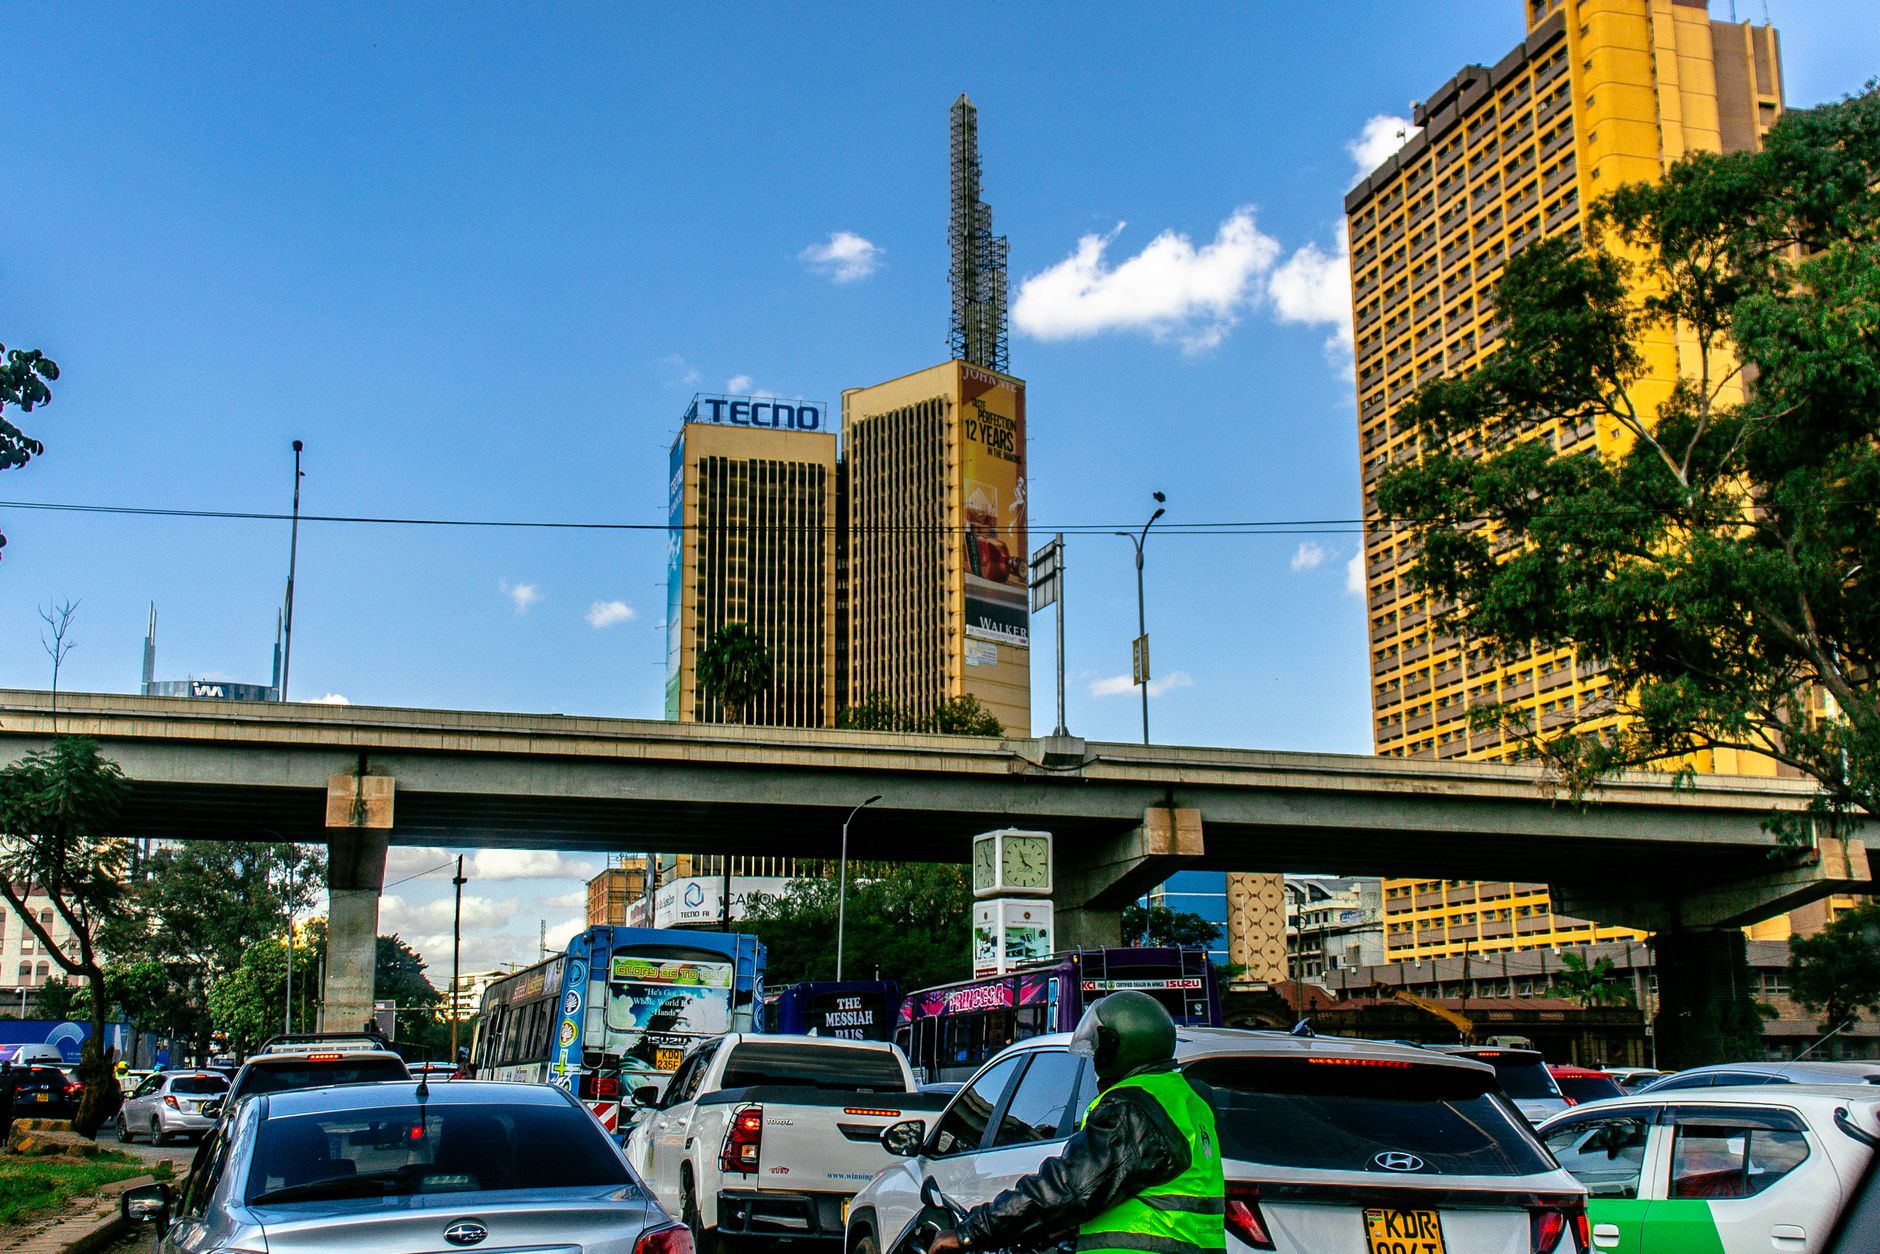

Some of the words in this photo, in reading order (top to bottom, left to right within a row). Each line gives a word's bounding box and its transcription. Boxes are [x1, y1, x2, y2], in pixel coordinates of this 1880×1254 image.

[705, 399, 819, 430] TECNO
[978, 409, 1017, 432] PERFECTION
[965, 419, 977, 441] 12
[979, 422, 1014, 453] YEARS
[980, 616, 1027, 638] WALKER
[681, 911, 700, 919] TECNO
[616, 965, 659, 978] GLORY
[660, 968, 679, 979] BE
[680, 970, 699, 980] TO
[1166, 979, 1200, 988] ISUZU
[659, 1000, 680, 1008] World
[836, 997, 862, 1010] THE
[825, 1010, 874, 1027] MESSIAH
[648, 1036, 687, 1045] ISUZU
[662, 1049, 680, 1060] KDQ
[767, 1118, 794, 1126] TOYOTA
[1383, 1210, 1436, 1239] KDR
